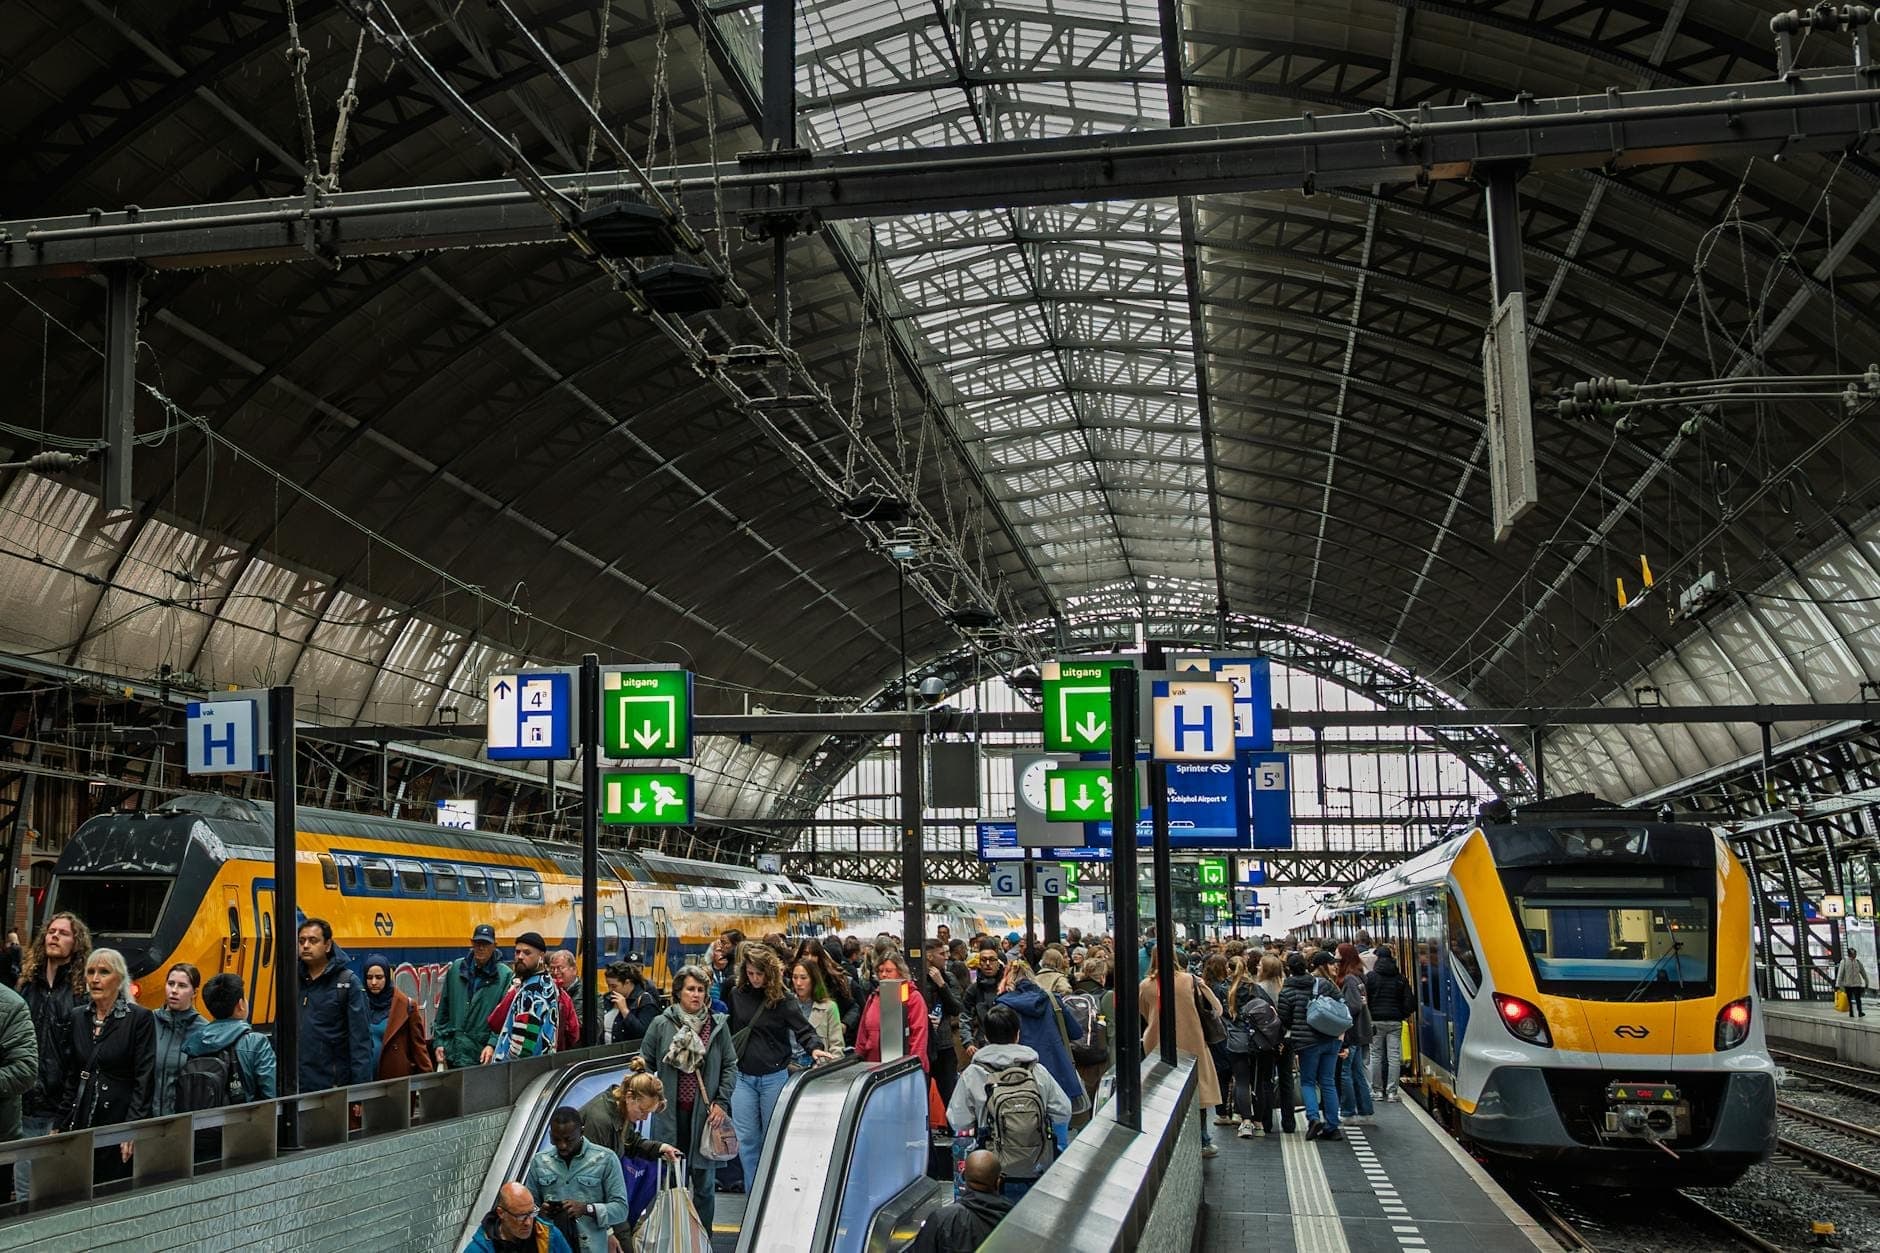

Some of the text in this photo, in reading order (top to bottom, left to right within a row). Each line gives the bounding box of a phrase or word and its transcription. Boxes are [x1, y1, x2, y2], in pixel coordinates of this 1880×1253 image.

[1062, 667, 1102, 678] uitgang
[623, 677, 659, 688] uitgang
[1171, 688, 1187, 696] vak
[202, 708, 215, 716] vak
[1174, 705, 1213, 751] H
[203, 723, 235, 766] H
[1176, 764, 1209, 774] Sprinter
[1171, 795, 1197, 803] Schiphol
[1198, 795, 1220, 803] Airport
[997, 875, 1012, 892] G
[1045, 878, 1059, 893] G
